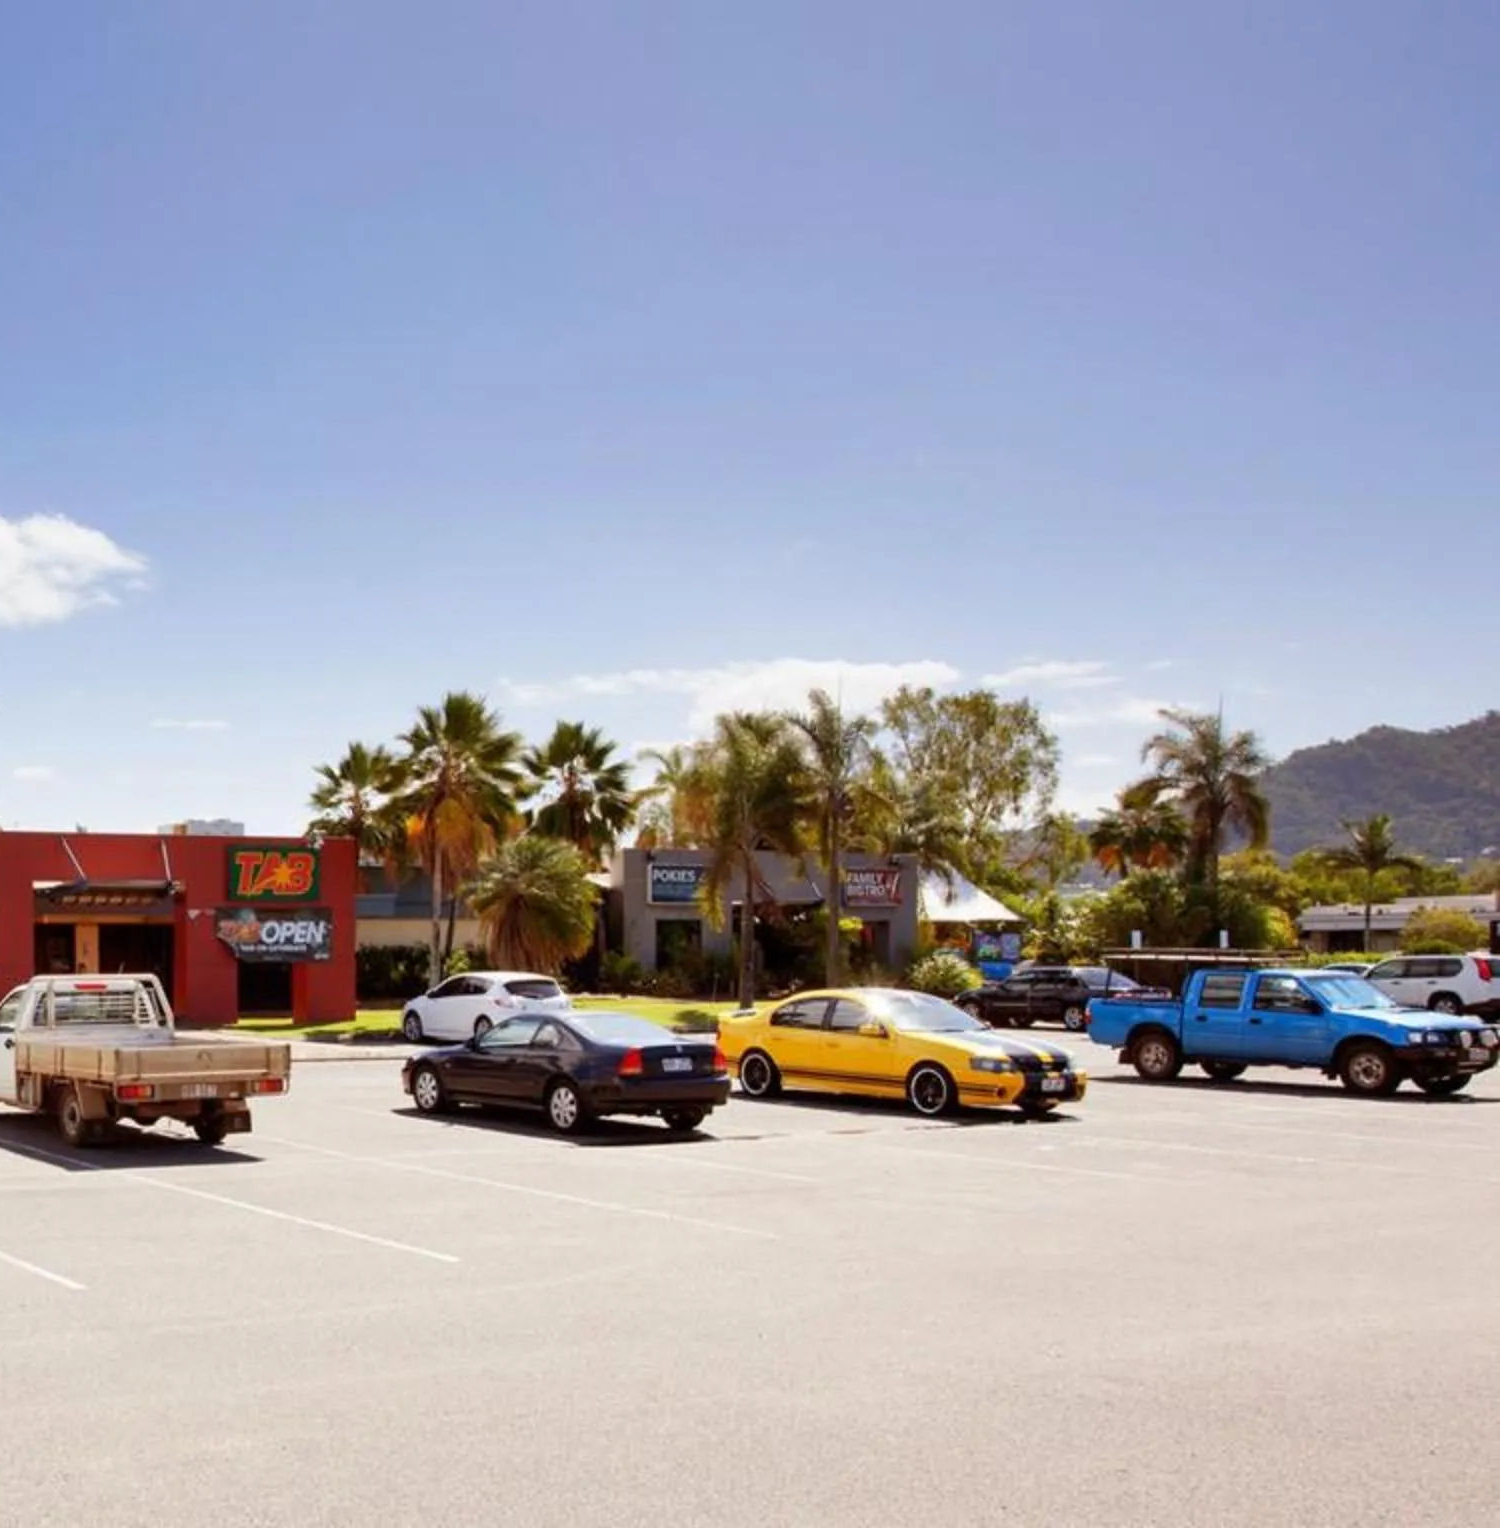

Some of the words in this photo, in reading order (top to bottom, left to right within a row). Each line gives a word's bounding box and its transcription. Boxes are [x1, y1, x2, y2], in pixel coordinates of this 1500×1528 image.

[235, 851, 315, 896] TAB
[653, 869, 697, 883] POKIES
[846, 871, 885, 884] FAMILY
[847, 884, 886, 897] BISTRO
[260, 919, 327, 944] OPEN
